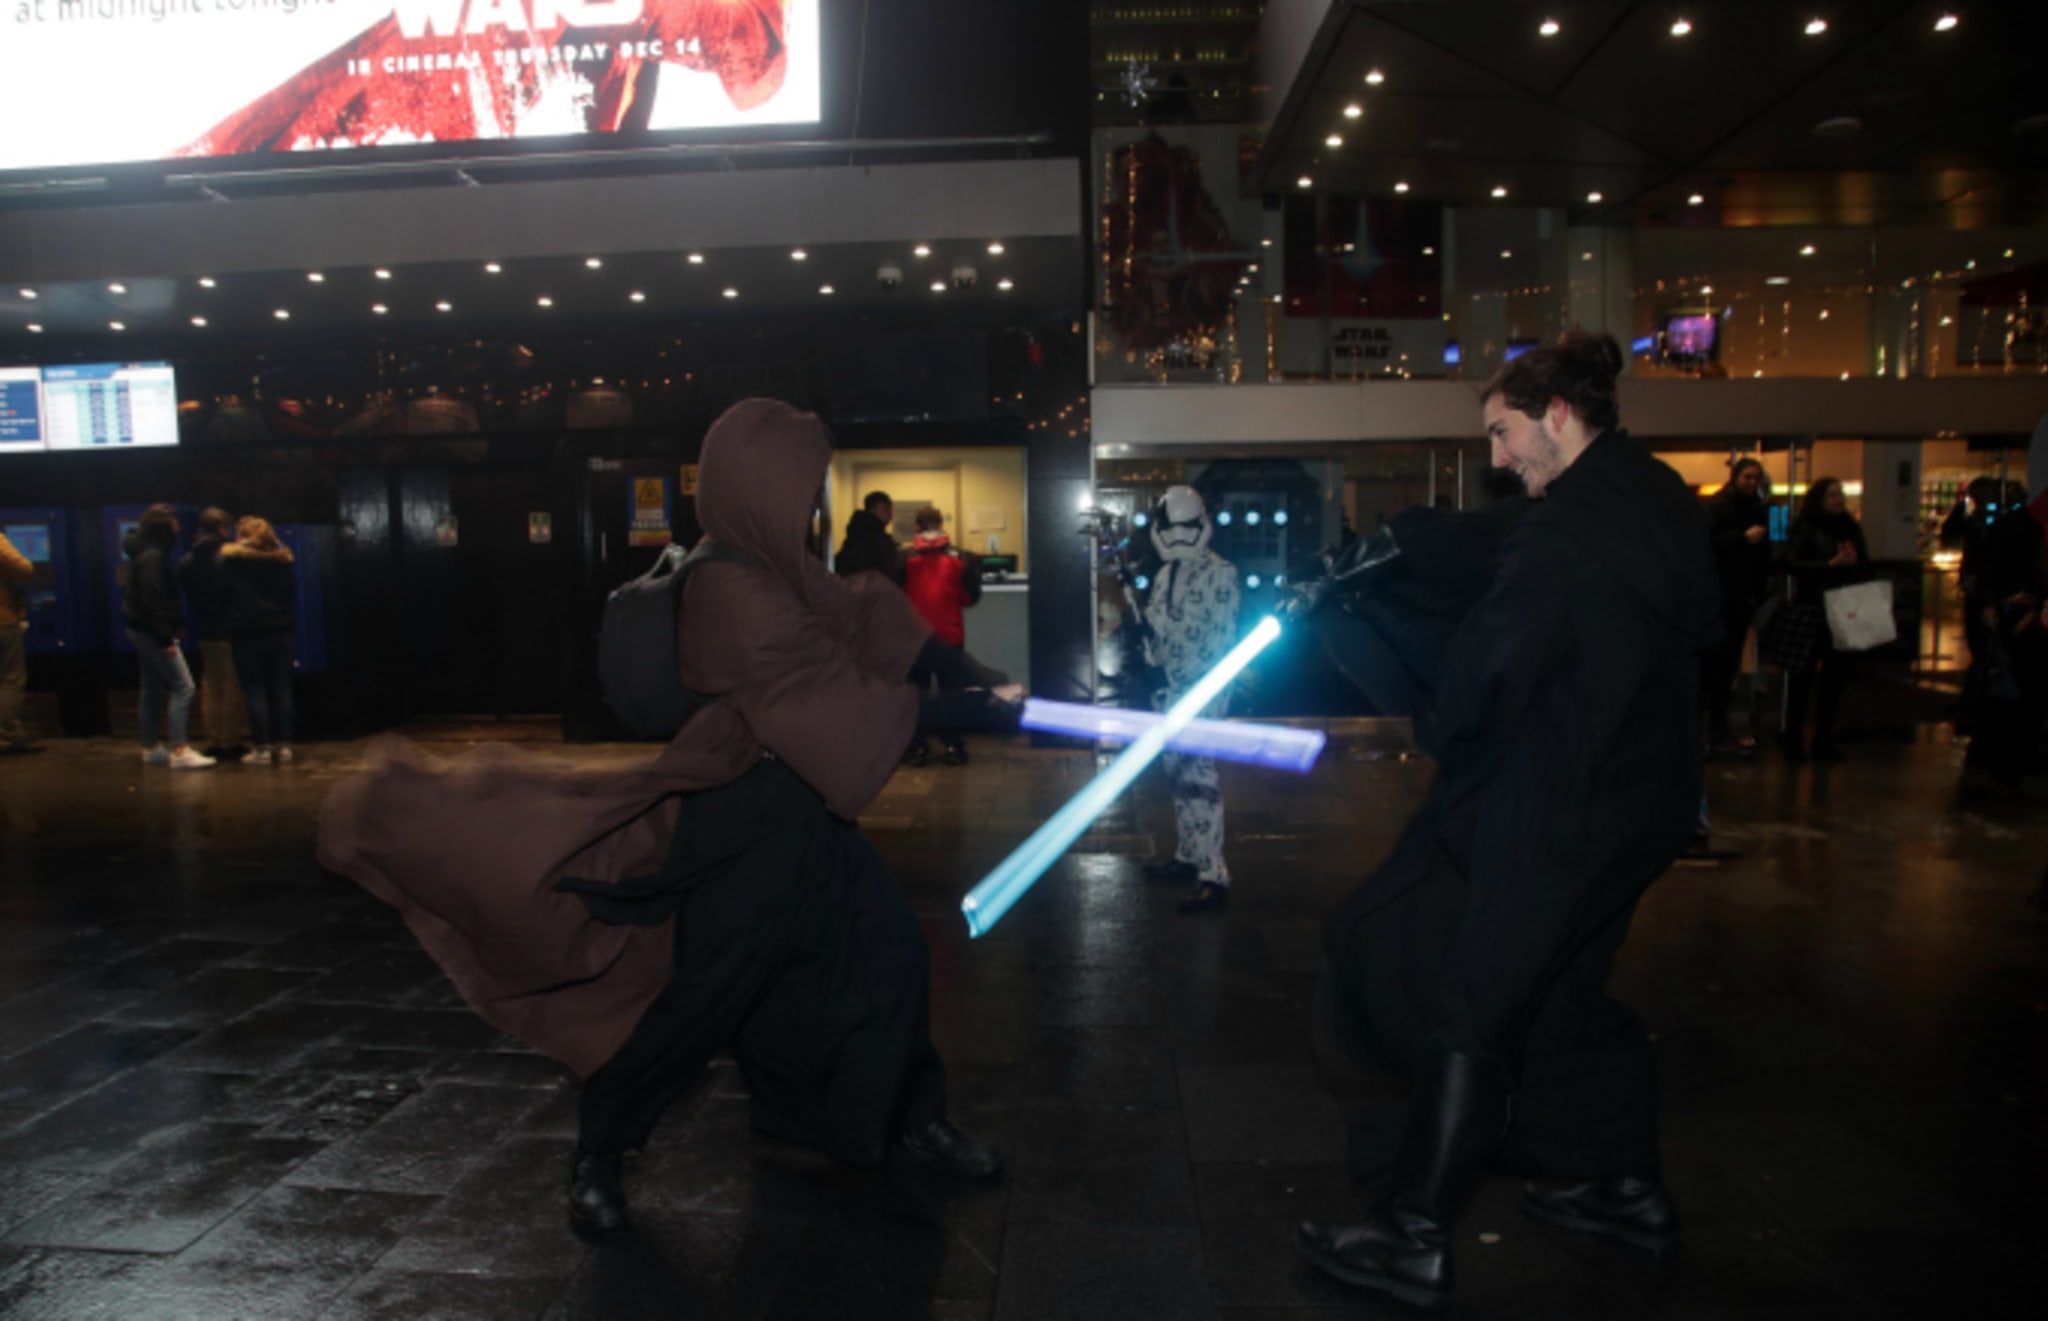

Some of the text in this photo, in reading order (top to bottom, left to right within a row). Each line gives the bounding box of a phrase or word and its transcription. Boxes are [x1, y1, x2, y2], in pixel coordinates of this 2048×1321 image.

[15, 0, 46, 23] at
[347, 36, 701, 76] IN CINEMAS THURSDAY DEC 14
